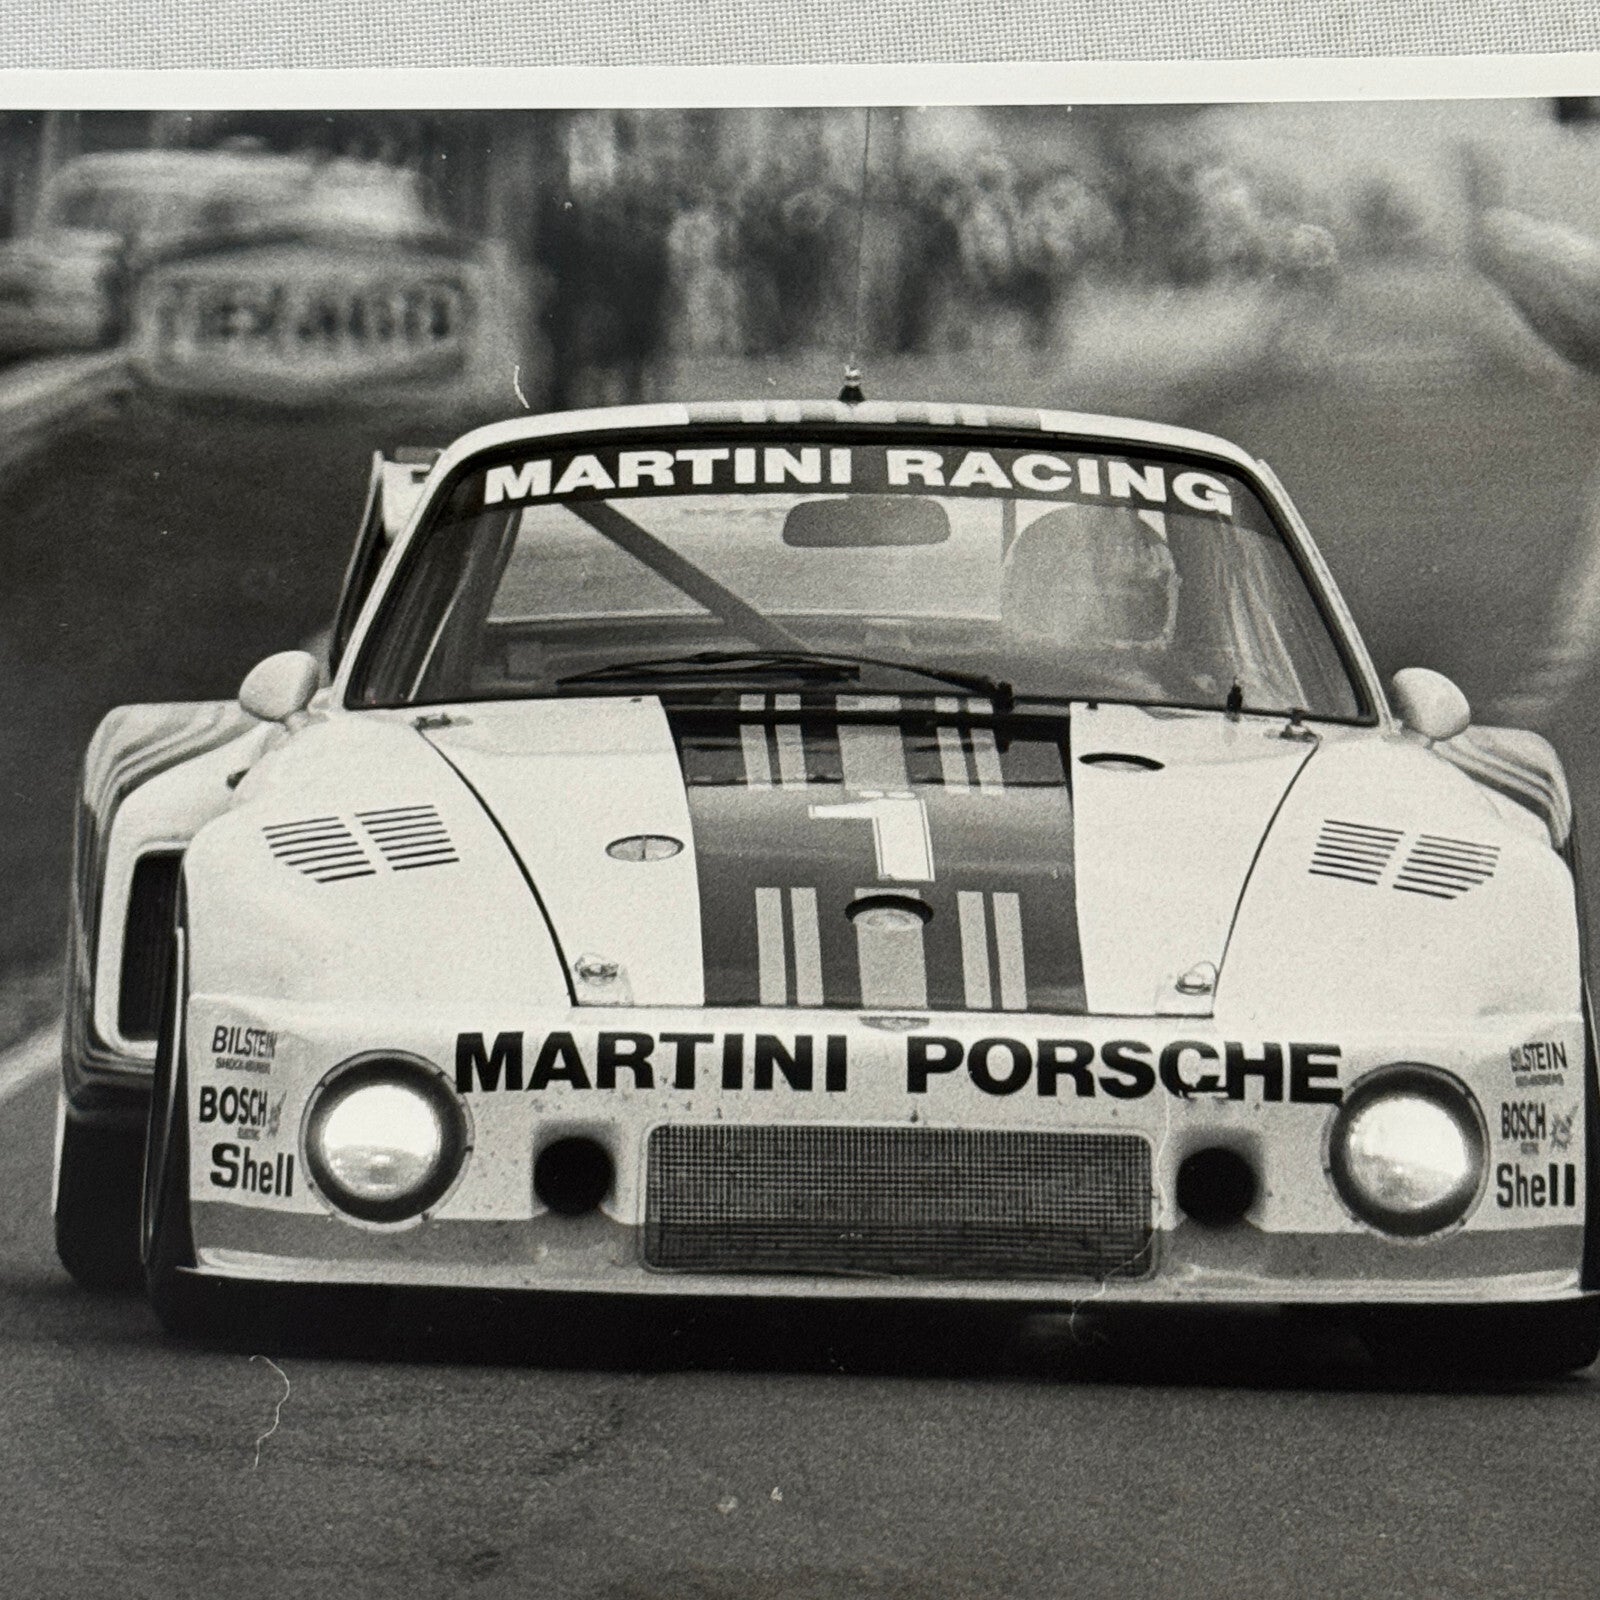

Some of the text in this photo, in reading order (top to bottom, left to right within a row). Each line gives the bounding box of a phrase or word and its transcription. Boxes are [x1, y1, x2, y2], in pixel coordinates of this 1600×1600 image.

[484, 447, 1233, 516] MARTINI RACING
[808, 791, 936, 882] 1
[456, 1031, 1343, 1101] MARTINI PORSCHE
[199, 1086, 268, 1127] BOSCH
[1501, 1102, 1546, 1140] BOSCH
[210, 1142, 294, 1197] Shell
[1496, 1163, 1575, 1208] Shell
